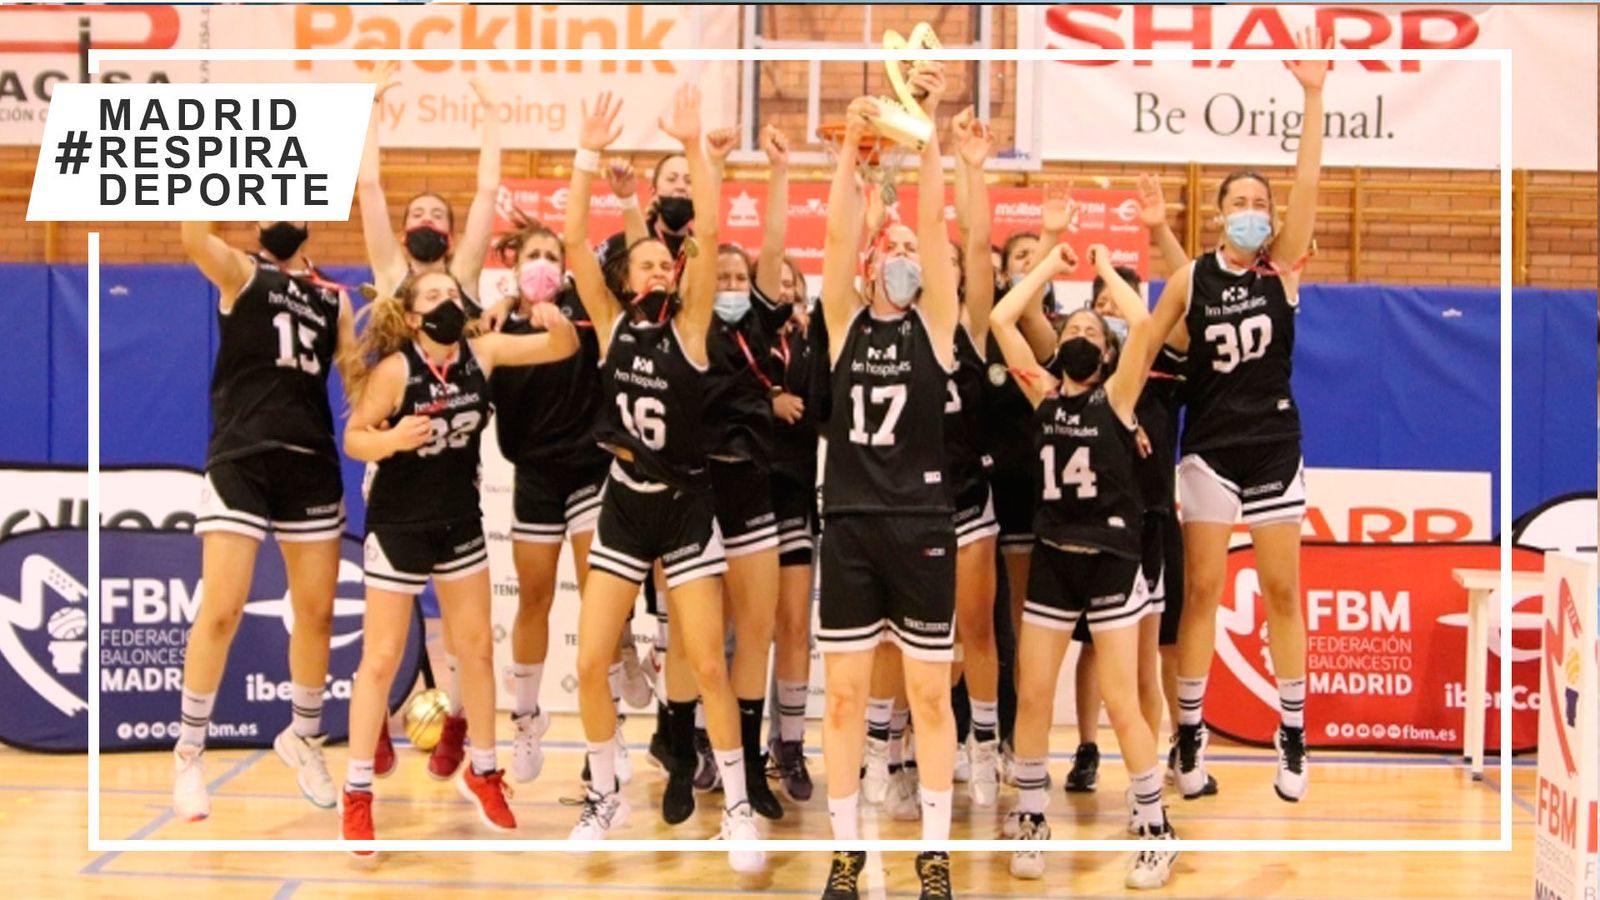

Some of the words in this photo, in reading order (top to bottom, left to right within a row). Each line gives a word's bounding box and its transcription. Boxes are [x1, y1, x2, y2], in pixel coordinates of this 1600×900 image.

[294, 5, 675, 74] Packlink
[1046, 6, 1481, 73] SHARP
[1133, 91, 1186, 135] Be
[1204, 93, 1395, 152] Orignal.
[272, 312, 321, 375] 15
[1204, 313, 1272, 373] 30
[615, 391, 666, 450] 16
[848, 384, 907, 446] 17
[1040, 444, 1098, 499] 14
[1303, 507, 1473, 542] ARP
[101, 578, 203, 624] FBM
[1306, 590, 1412, 633] FBM
[1308, 634, 1413, 654] FEDERACIÓN
[1308, 655, 1413, 672] BALONCESTO
[1309, 673, 1413, 696] MADRID
[208, 721, 259, 738] bm.es
[1537, 776, 1577, 848] FBM
